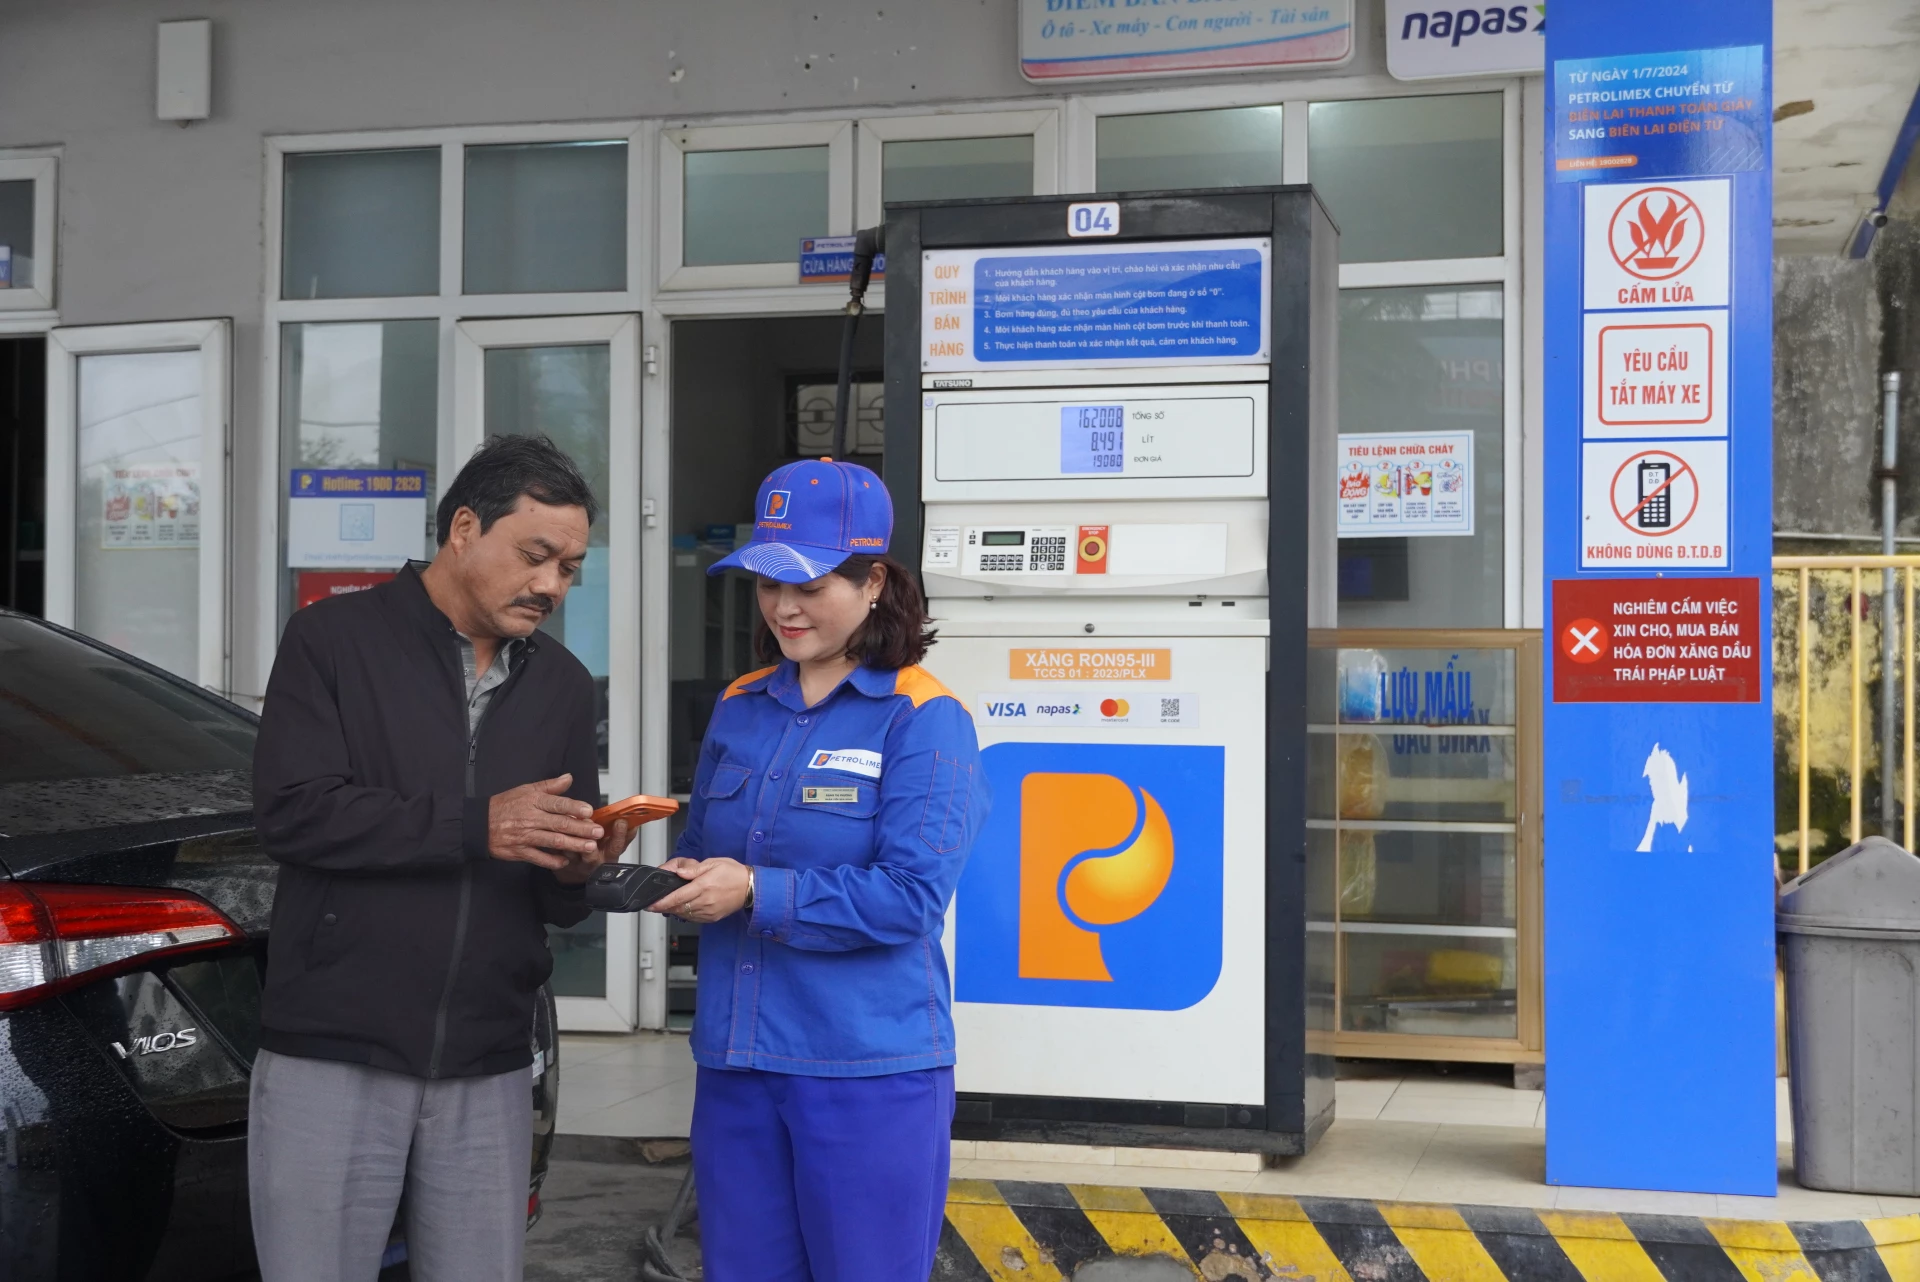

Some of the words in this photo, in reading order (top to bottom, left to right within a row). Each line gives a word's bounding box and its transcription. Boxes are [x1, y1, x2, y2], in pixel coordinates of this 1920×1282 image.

[1041, 19, 1055, 39] Ô
[1059, 22, 1074, 38] tô
[1090, 20, 1112, 36] Xe
[1116, 17, 1149, 37] máy
[1166, 15, 1198, 31] Con
[1203, 11, 1252, 32] người
[1271, 8, 1297, 25] Tài
[1301, 5, 1330, 22] sản
[1401, 5, 1528, 47] napas
[1569, 70, 1589, 84] TỪ
[1591, 67, 1629, 83] NGÀY
[1632, 64, 1688, 79] 1/7/2024
[1568, 88, 1652, 105] PETROLIMEX
[1654, 81, 1710, 98] CHUYỂN
[1714, 80, 1734, 94] TỪ
[1568, 128, 1605, 140] SANG
[1609, 125, 1640, 138] BIÊN
[1644, 123, 1664, 135] LAI
[1668, 120, 1701, 134] ĐIỆN
[1075, 207, 1112, 232] 04
[803, 257, 826, 273] CỬA
[934, 265, 960, 280] QUY
[929, 288, 967, 305] TRÌNH
[1618, 282, 1656, 304] CẤM
[1662, 281, 1694, 303] LỬA
[934, 313, 960, 331] BÁN
[929, 340, 964, 357] HÀNG
[1623, 348, 1652, 372] YÊU
[1657, 344, 1688, 371] CẦU
[934, 379, 971, 388] TATSUNO
[1610, 378, 1637, 405] TẮT
[1642, 381, 1676, 404] MÁY
[1681, 384, 1700, 404] XE
[1079, 408, 1123, 429] 162008
[1132, 411, 1152, 420] TỔNG
[1154, 411, 1165, 420] SỐ
[1141, 435, 1155, 444] LÍT
[1348, 445, 1369, 457] TIÊU
[1372, 444, 1397, 457] LỆNH
[1399, 442, 1426, 456] CHỮA
[1428, 443, 1454, 455] CHÁY
[1092, 454, 1123, 468] 19080
[322, 476, 364, 492] Hotline:
[366, 476, 393, 491] 1900
[395, 476, 422, 491] 2828
[1587, 543, 1632, 559] KHÔNG
[1636, 543, 1673, 559] DÙNG
[1677, 545, 1722, 559] Đ.T.D.Đ
[1613, 598, 1667, 615] NGHIÊM
[1670, 596, 1701, 614] CẤM
[1705, 598, 1738, 617] VIỆC
[1613, 624, 1636, 637] XIN
[1639, 623, 1673, 638] CHO,
[1676, 624, 1706, 636] MUA
[1709, 620, 1739, 636] BÁN
[1613, 643, 1643, 659] HÓA
[1646, 644, 1675, 659] ĐƠN
[1679, 643, 1719, 659] XĂNG
[1722, 640, 1751, 659] DẦU
[1026, 650, 1074, 667] XĂNG
[1079, 653, 1156, 668] RON95-III
[1033, 668, 1066, 679] TCCS
[1069, 668, 1082, 678] 01
[1093, 668, 1146, 679] 2023/PLX
[1613, 665, 1645, 681] TRÁI
[1649, 665, 1686, 681] PHÁP
[1690, 665, 1725, 683] LUẬT
[1380, 666, 1418, 719] LƯU
[1424, 653, 1471, 719] MẪU
[984, 702, 1027, 717] VISA
[1036, 705, 1071, 717] napas
[829, 755, 882, 769] PETROLIME
[110, 1027, 197, 1060] VIOS
